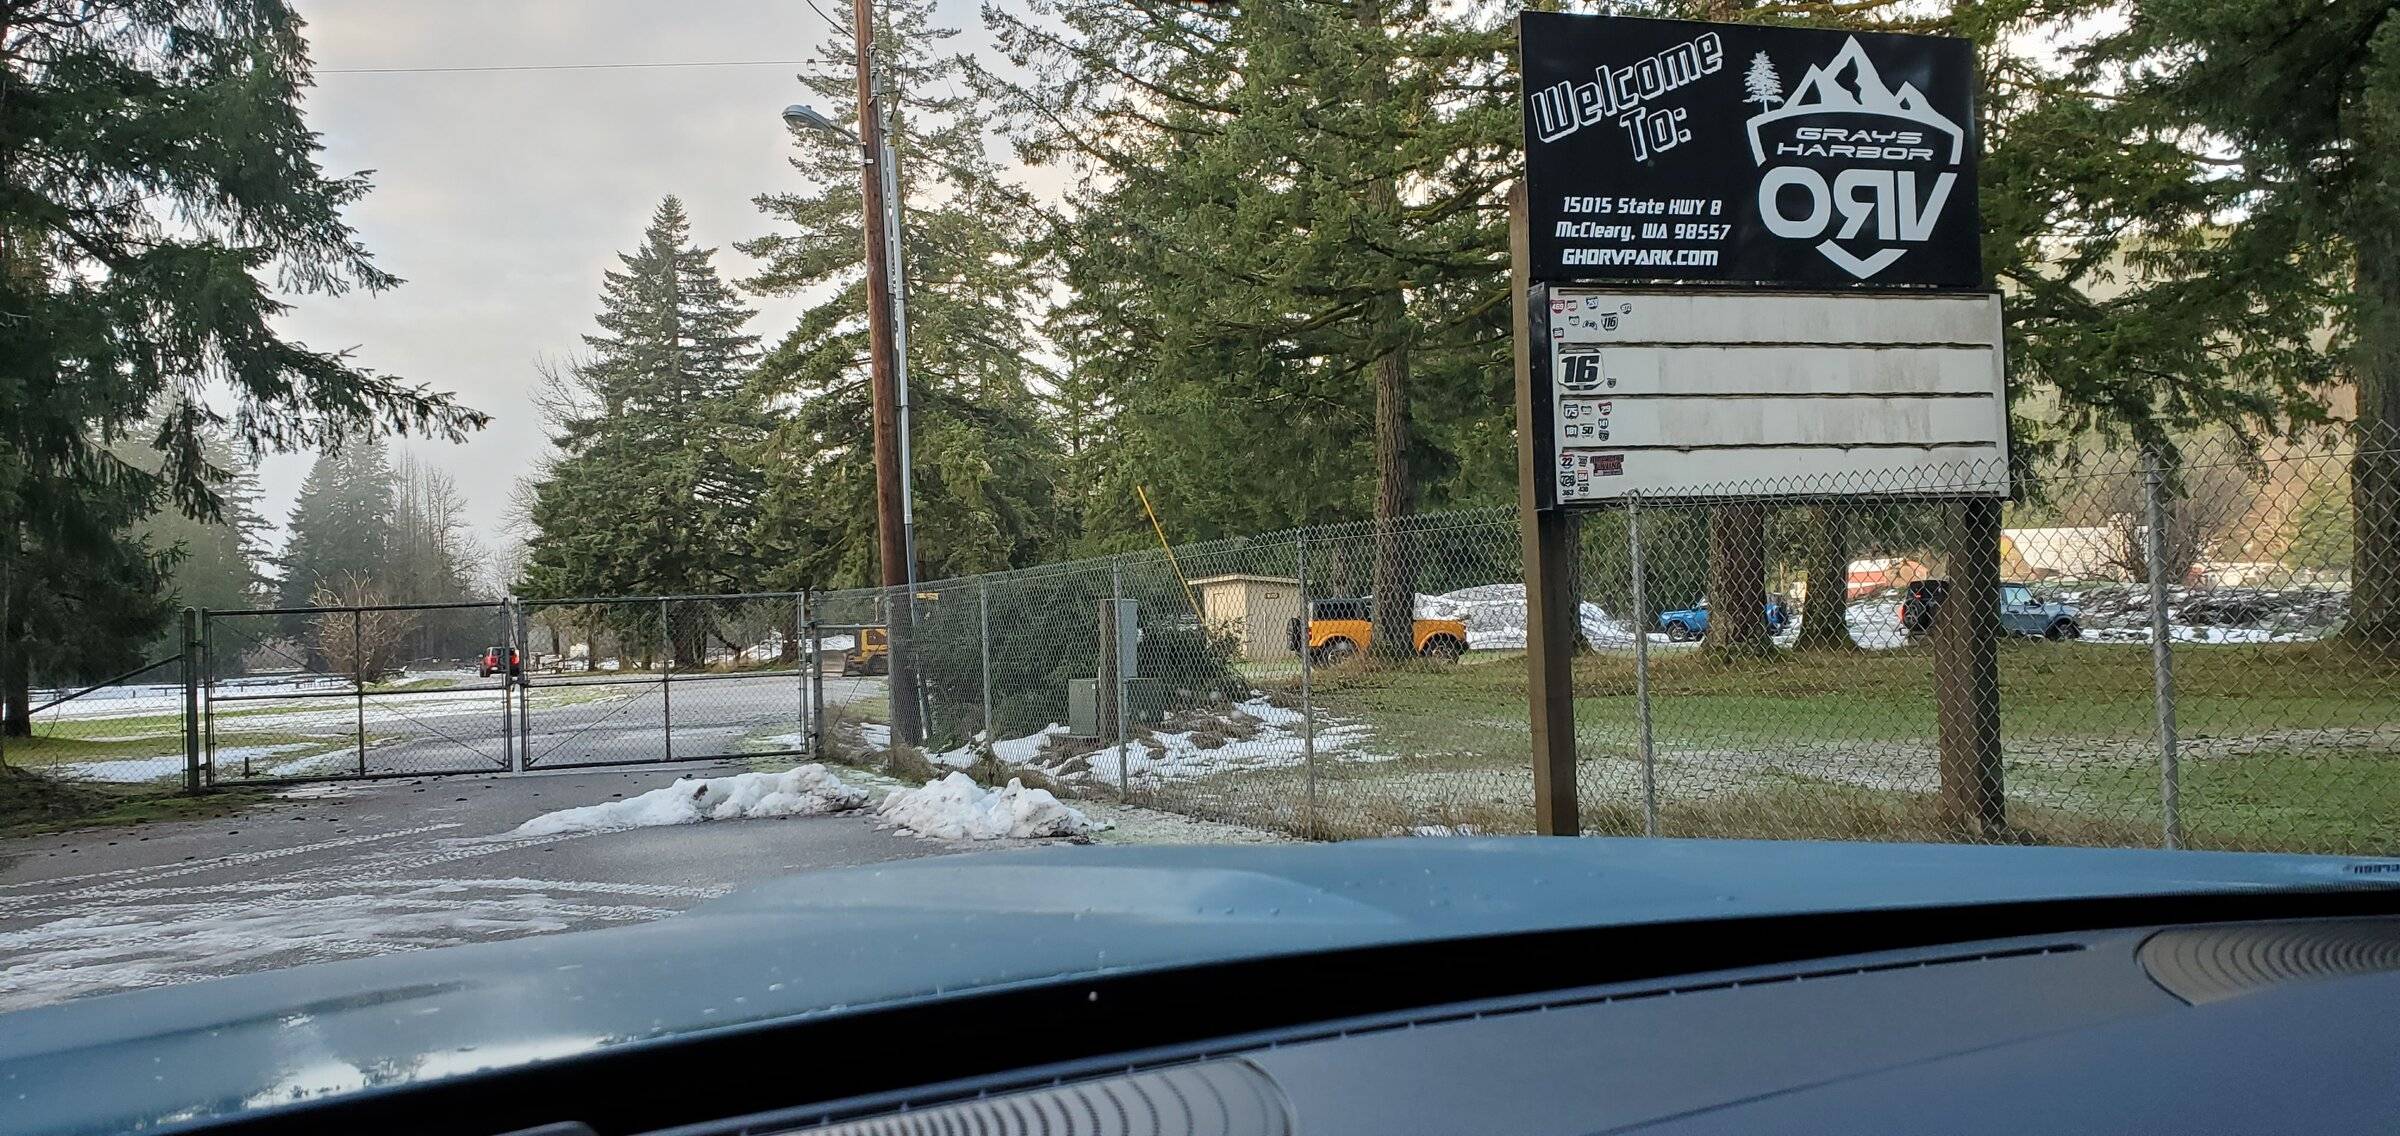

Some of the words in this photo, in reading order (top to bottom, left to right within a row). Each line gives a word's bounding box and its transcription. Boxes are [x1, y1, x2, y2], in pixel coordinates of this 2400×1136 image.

[1531, 31, 1723, 143] Welcome
[1619, 106, 1692, 162] To:
[1796, 127, 1923, 145] GRAYS
[1776, 142, 1934, 161] HARBOR
[1563, 196, 1613, 214] 15015
[1617, 197, 1665, 215] State
[1668, 199, 1706, 216] HWY
[1710, 199, 1723, 216] 8
[1758, 166, 1958, 242] ORV
[1555, 221, 1636, 242] McCleary,
[1641, 223, 1668, 239] WA
[1674, 223, 1732, 240] 98557
[1561, 355, 1600, 383] 16
